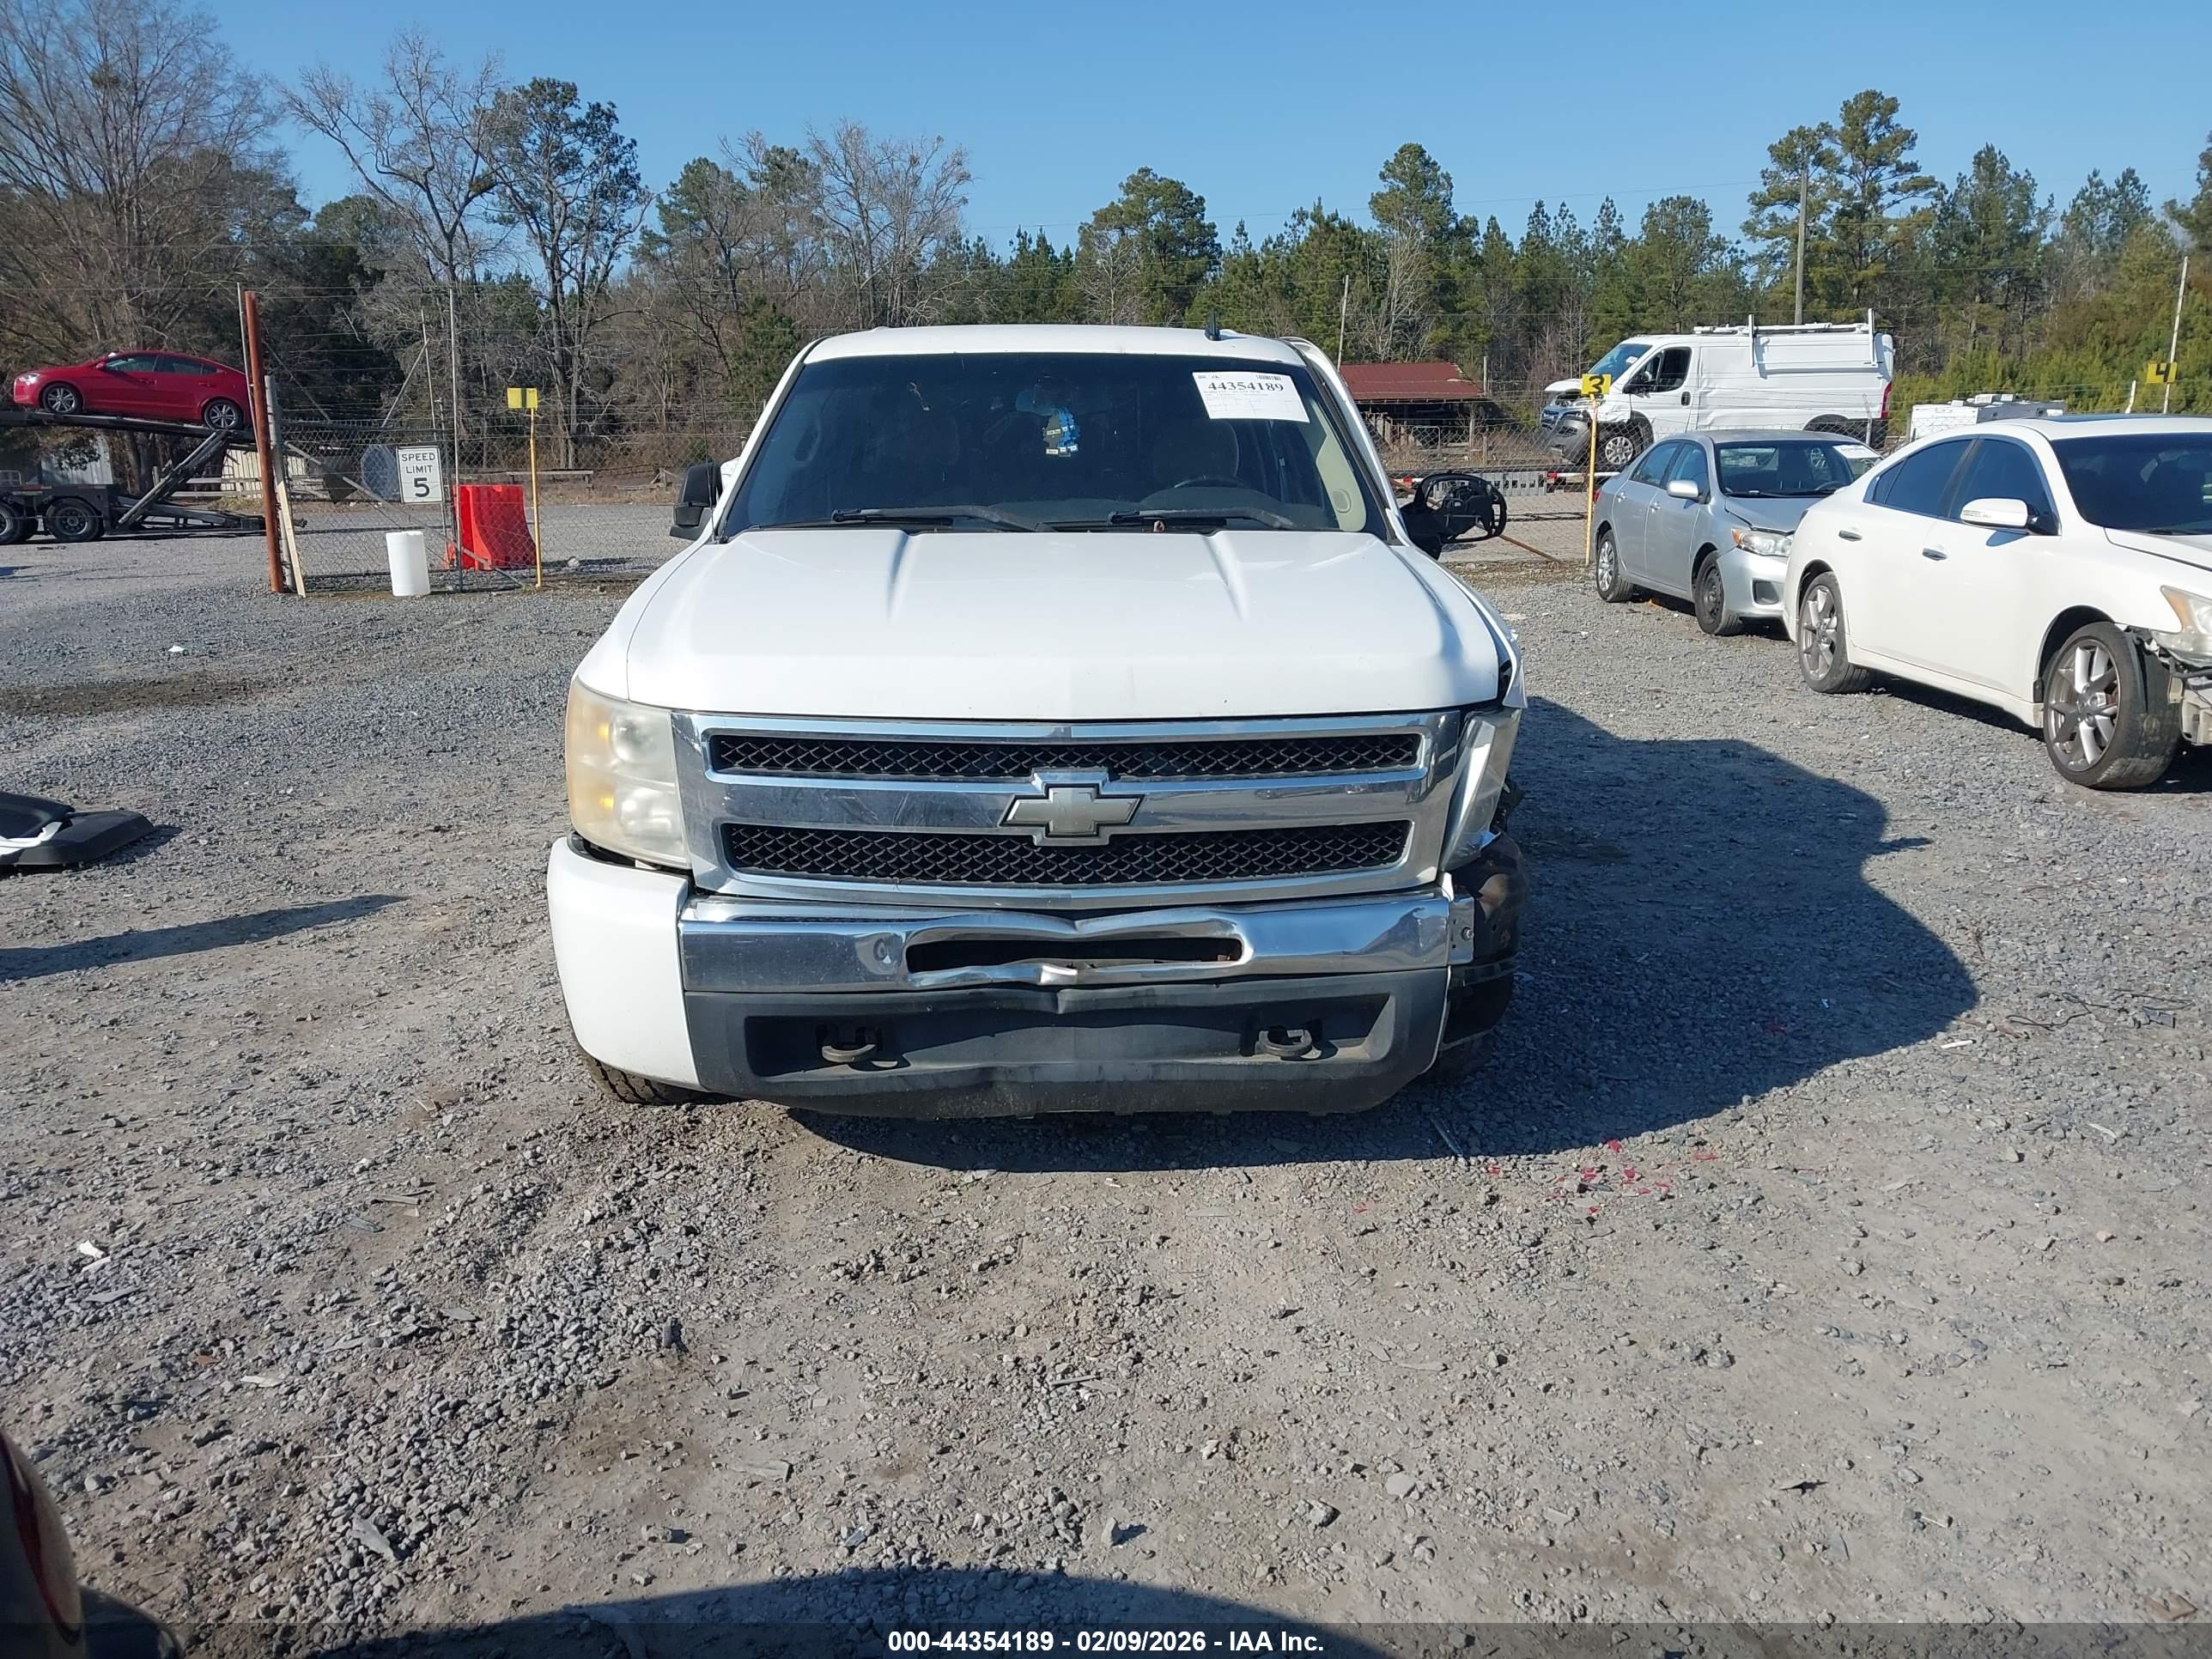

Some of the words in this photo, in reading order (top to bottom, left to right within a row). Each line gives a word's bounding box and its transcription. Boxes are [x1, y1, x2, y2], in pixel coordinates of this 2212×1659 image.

[2156, 362, 2171, 383] 4
[1208, 381, 1284, 392] 44354189
[1589, 374, 1604, 394] 3
[401, 453, 435, 462] SPEED
[405, 465, 434, 474] LIMIT
[413, 477, 430, 498] 5
